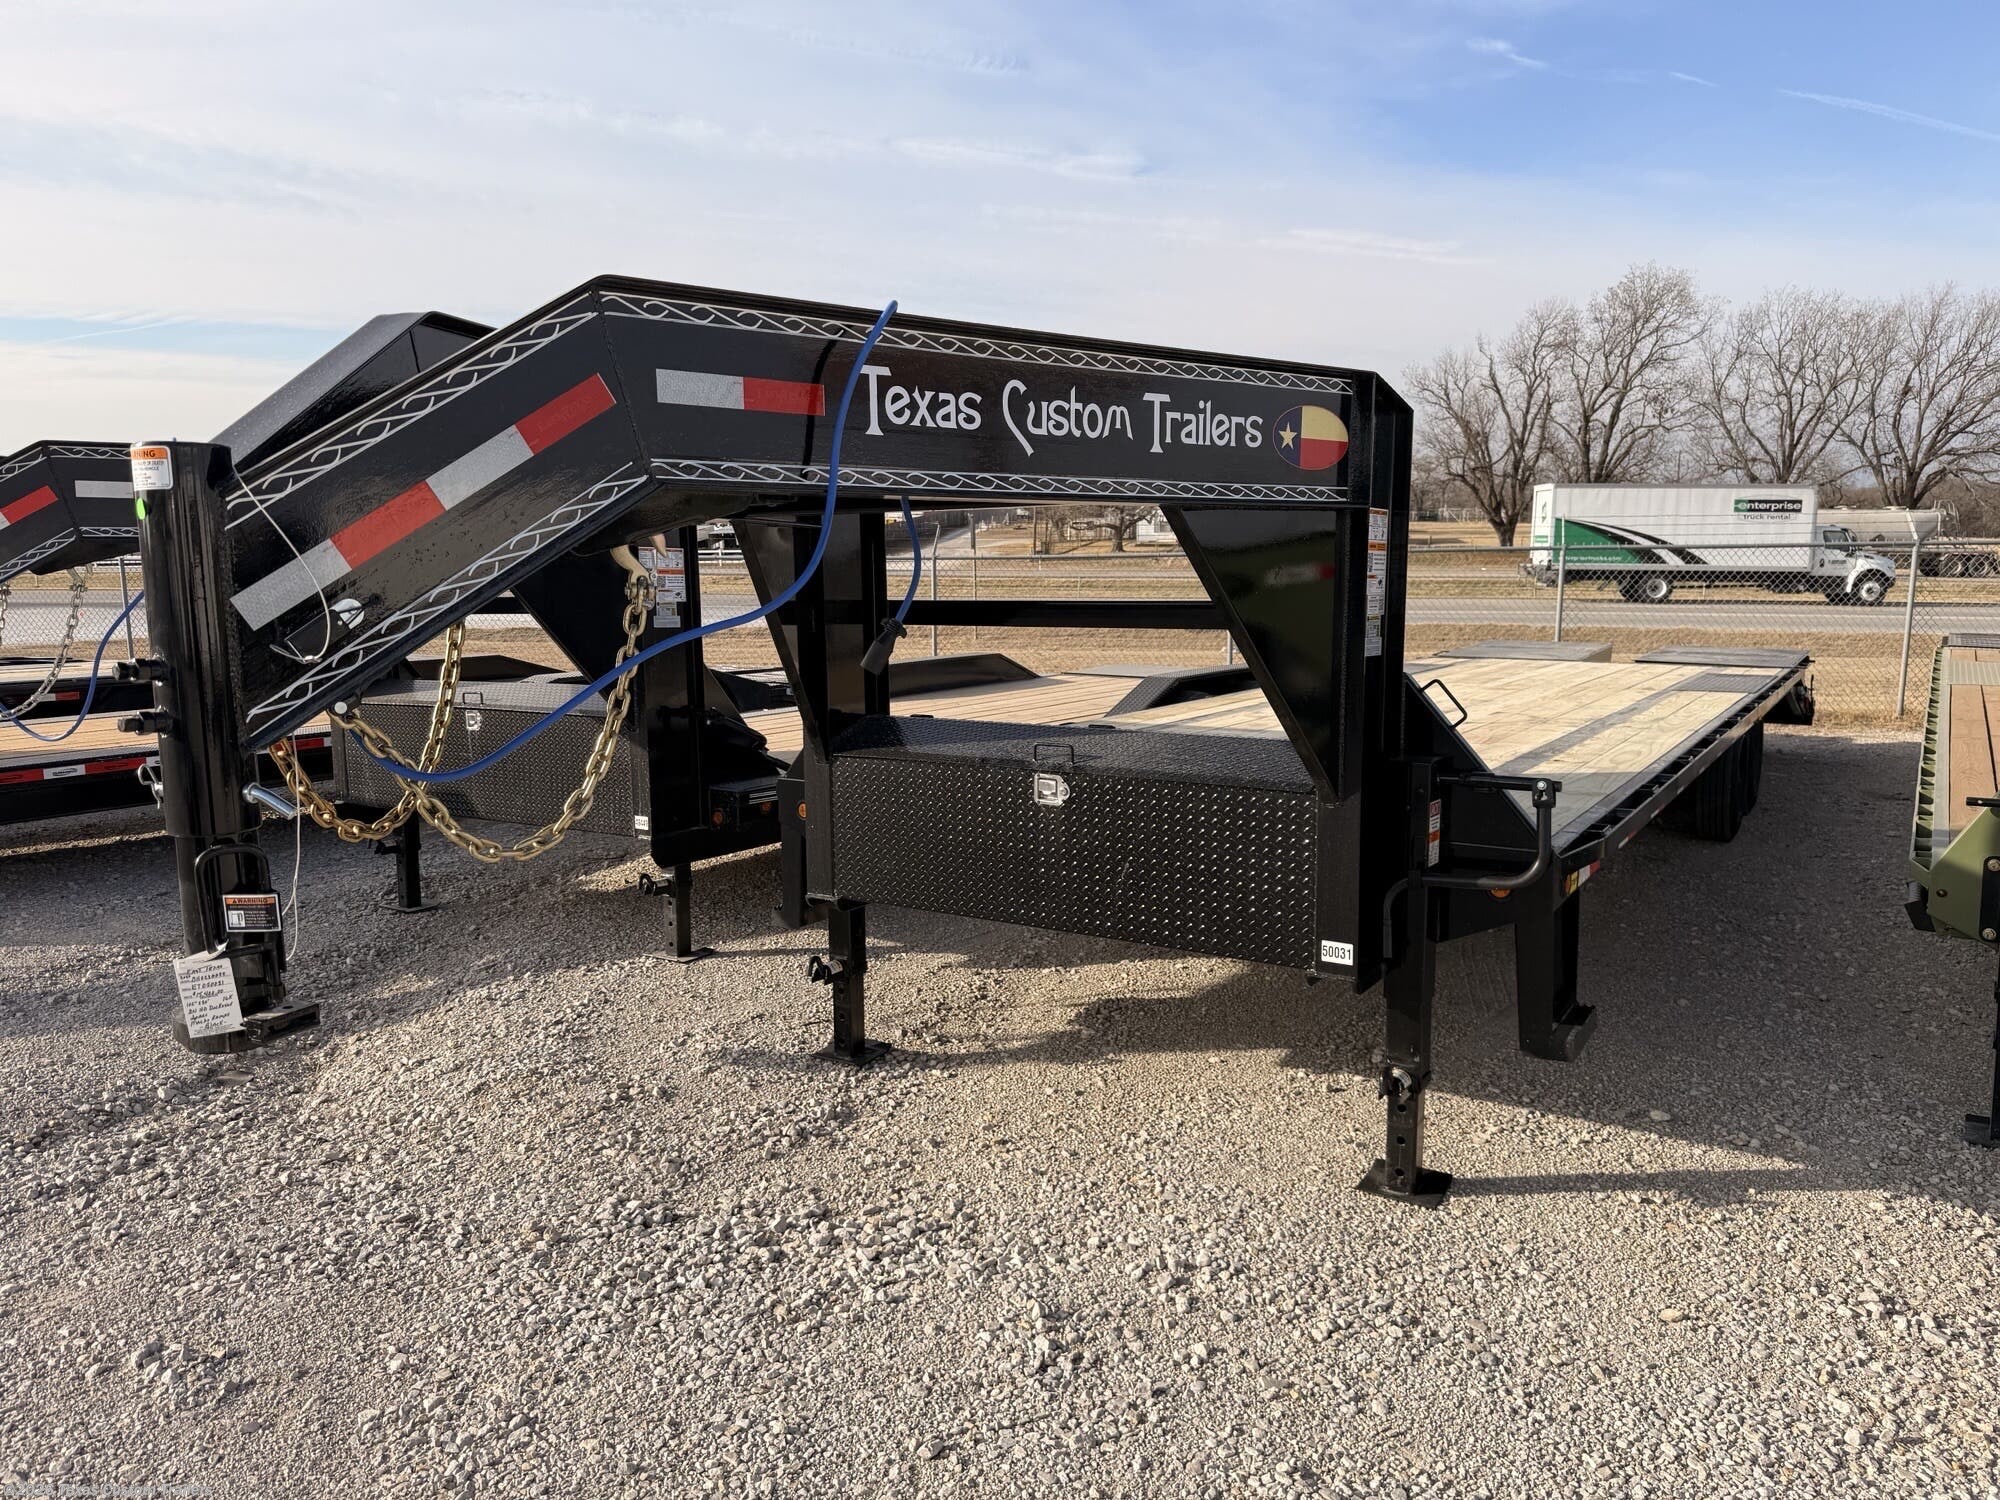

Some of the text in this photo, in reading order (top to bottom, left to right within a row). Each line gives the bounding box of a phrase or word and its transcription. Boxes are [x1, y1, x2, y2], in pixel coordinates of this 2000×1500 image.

[861, 365, 1263, 456] Texas Custom Trailers
[1734, 501, 1802, 511] enterprise
[1322, 945, 1351, 961] 50031
